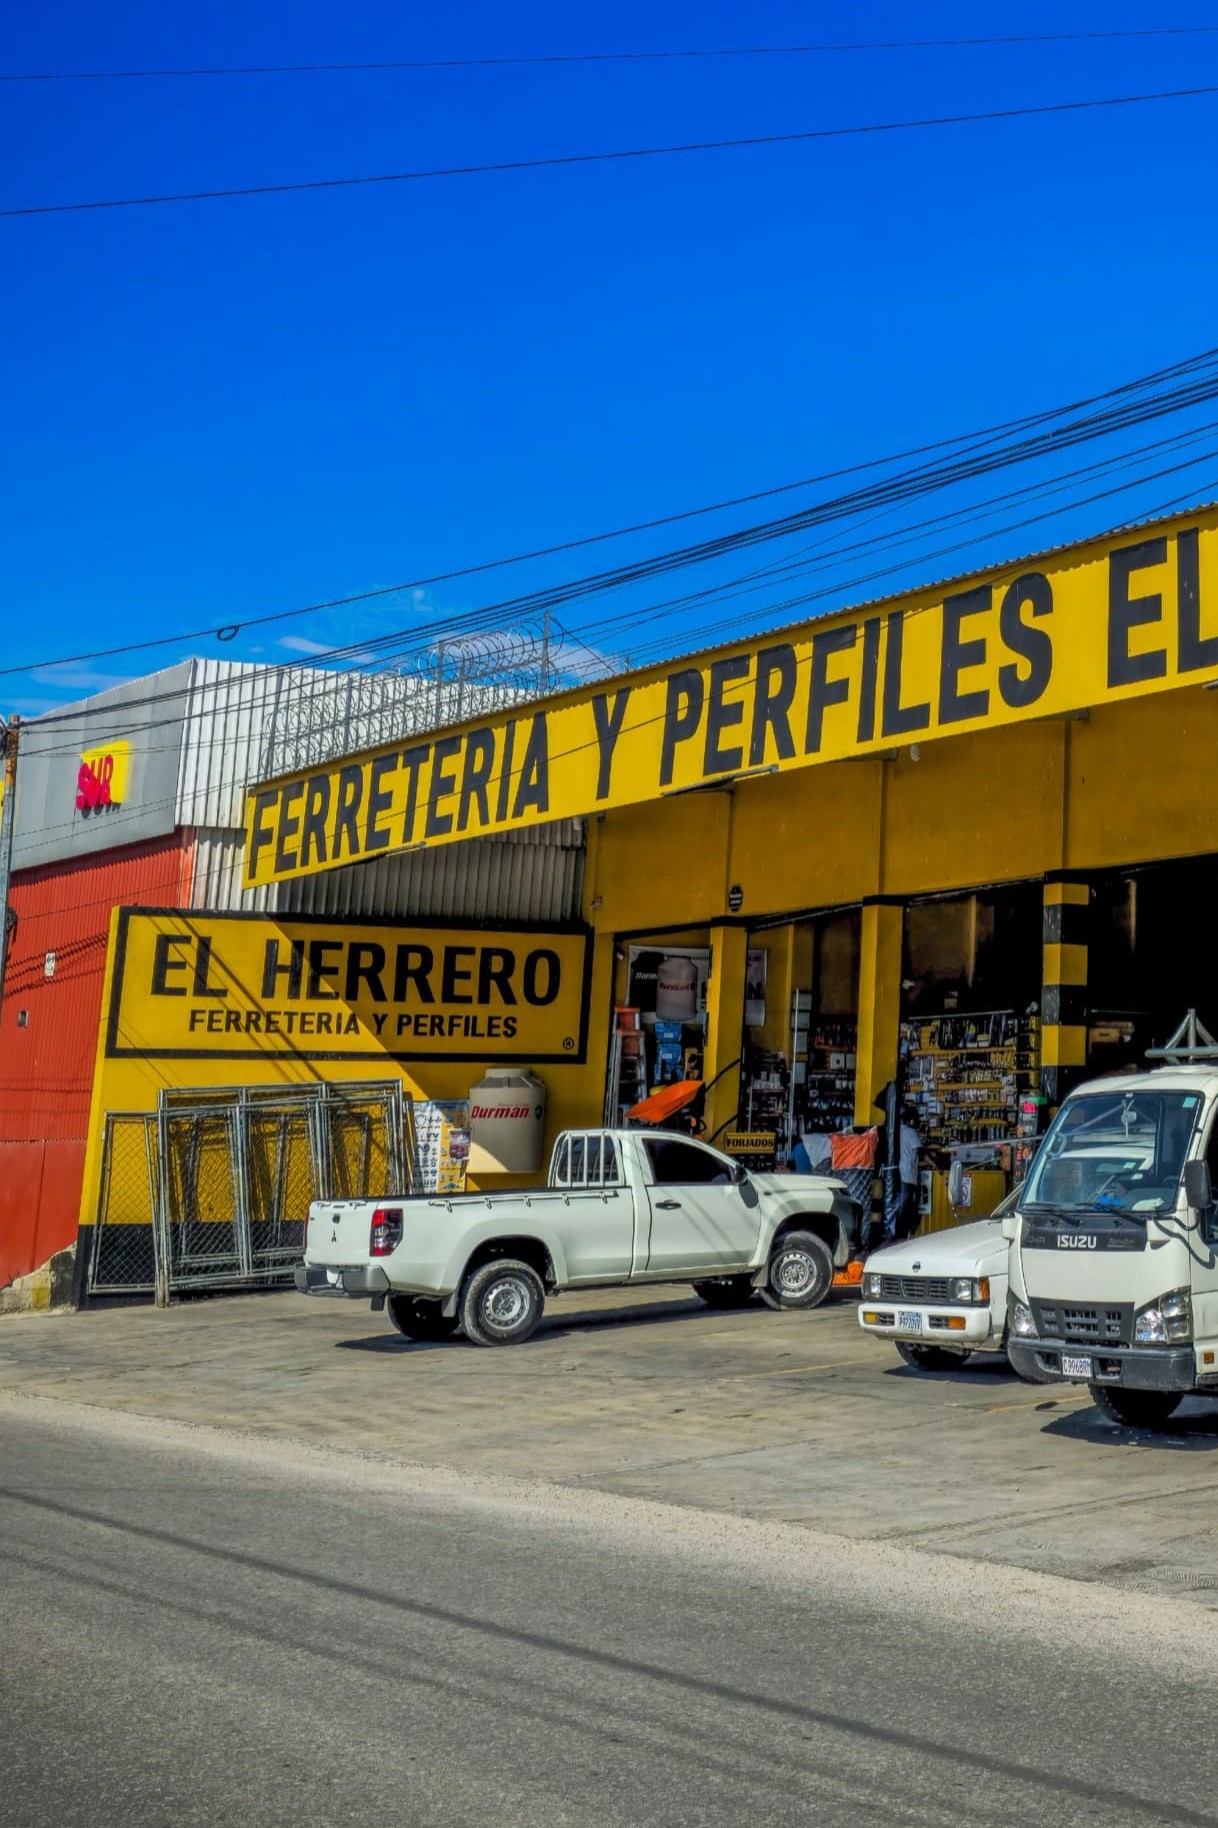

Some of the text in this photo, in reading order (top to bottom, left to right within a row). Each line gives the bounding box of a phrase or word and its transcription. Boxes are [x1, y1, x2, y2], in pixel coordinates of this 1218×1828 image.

[248, 711, 550, 880] FERRETERIA
[591, 686, 632, 801] Y
[659, 572, 1054, 787] PERFILES
[150, 934, 561, 1007] EL HERRERO
[188, 1008, 518, 1038] FERRETERIA Y PERFILES
[471, 1104, 530, 1119] Durman
[727, 1138, 774, 1148] FORJADOS
[1056, 1234, 1097, 1249] ISUZU
